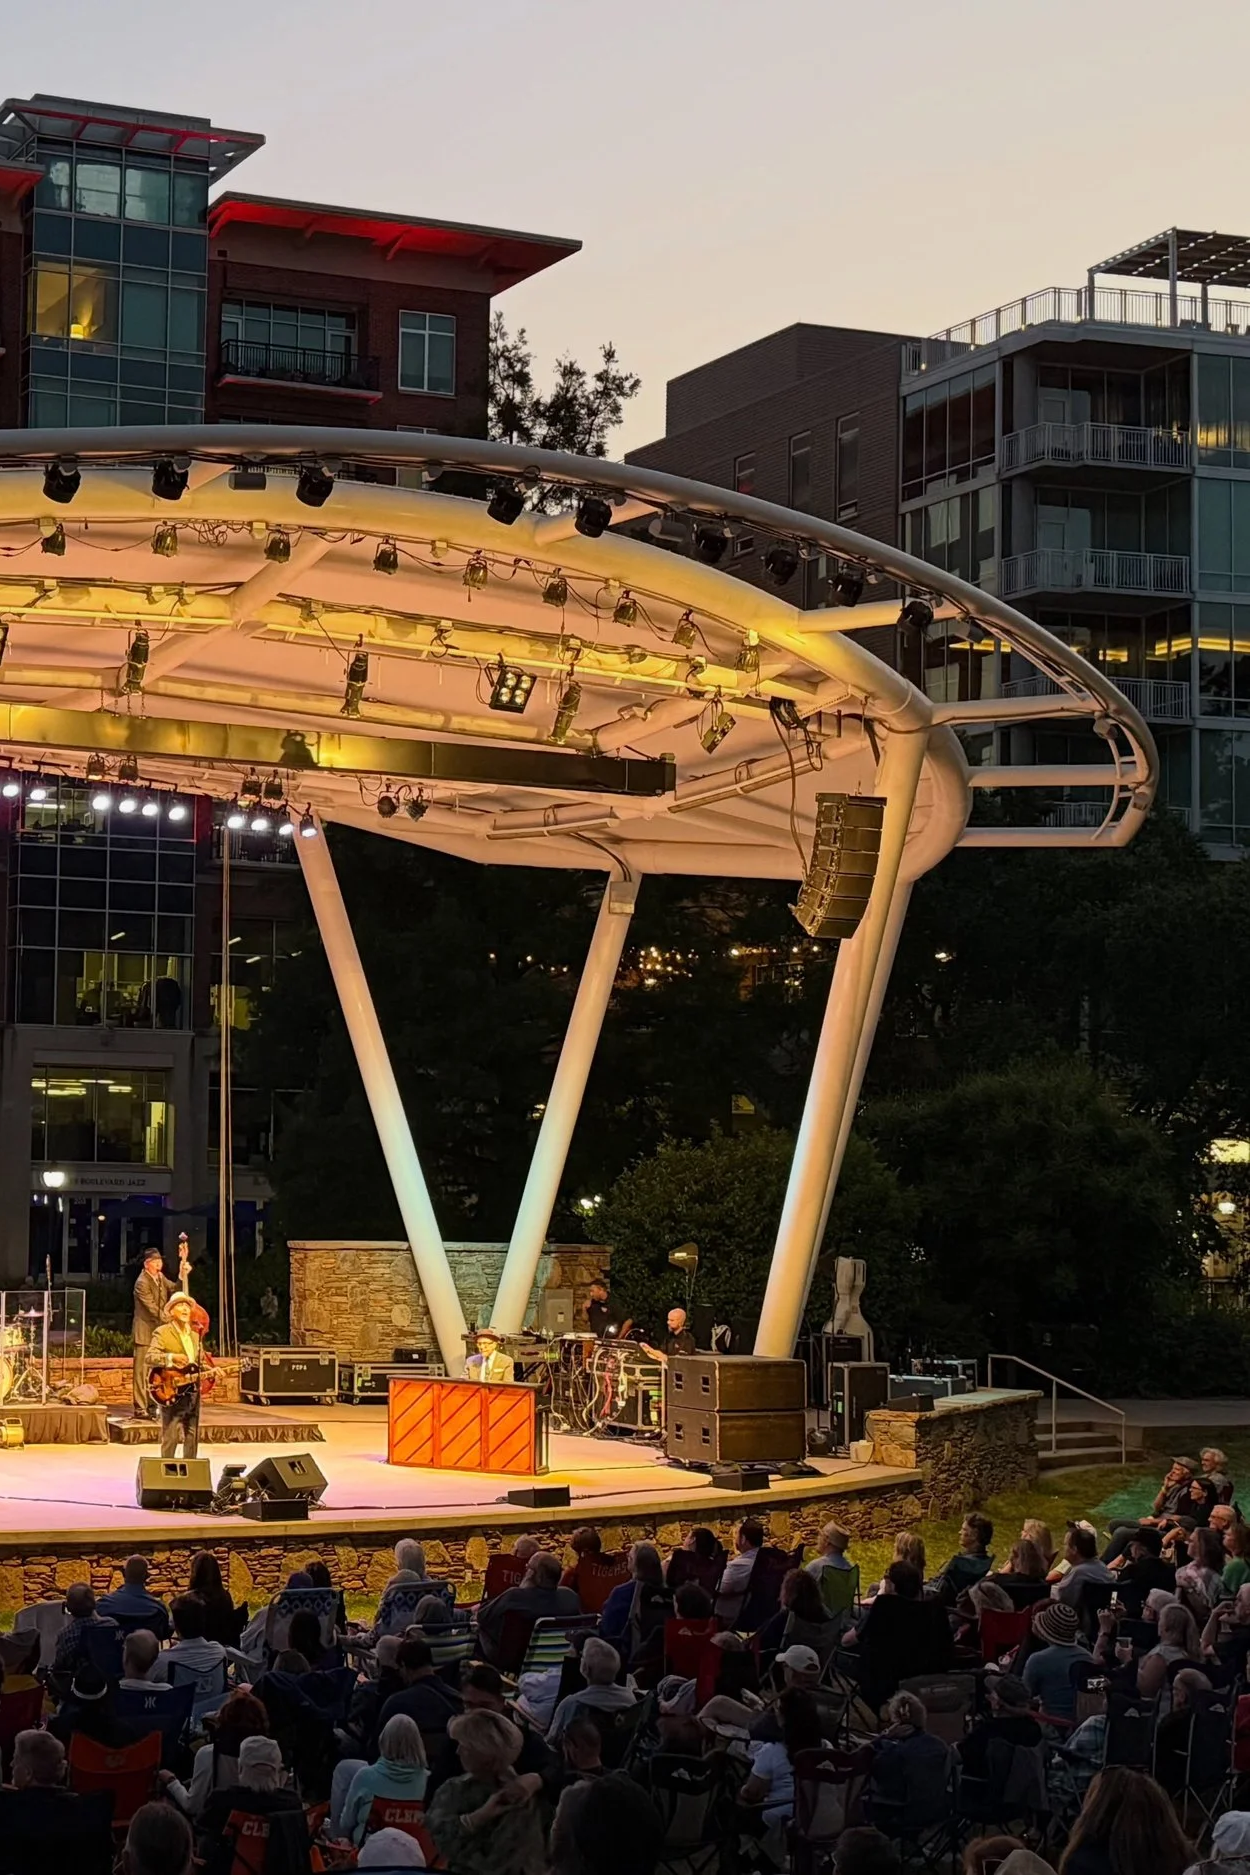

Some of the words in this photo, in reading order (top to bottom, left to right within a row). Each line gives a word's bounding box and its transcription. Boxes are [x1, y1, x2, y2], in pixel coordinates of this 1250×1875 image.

[127, 1178, 146, 1186] JAZZ
[501, 1569, 522, 1585] TIG
[591, 1561, 628, 1577] TIGERS
